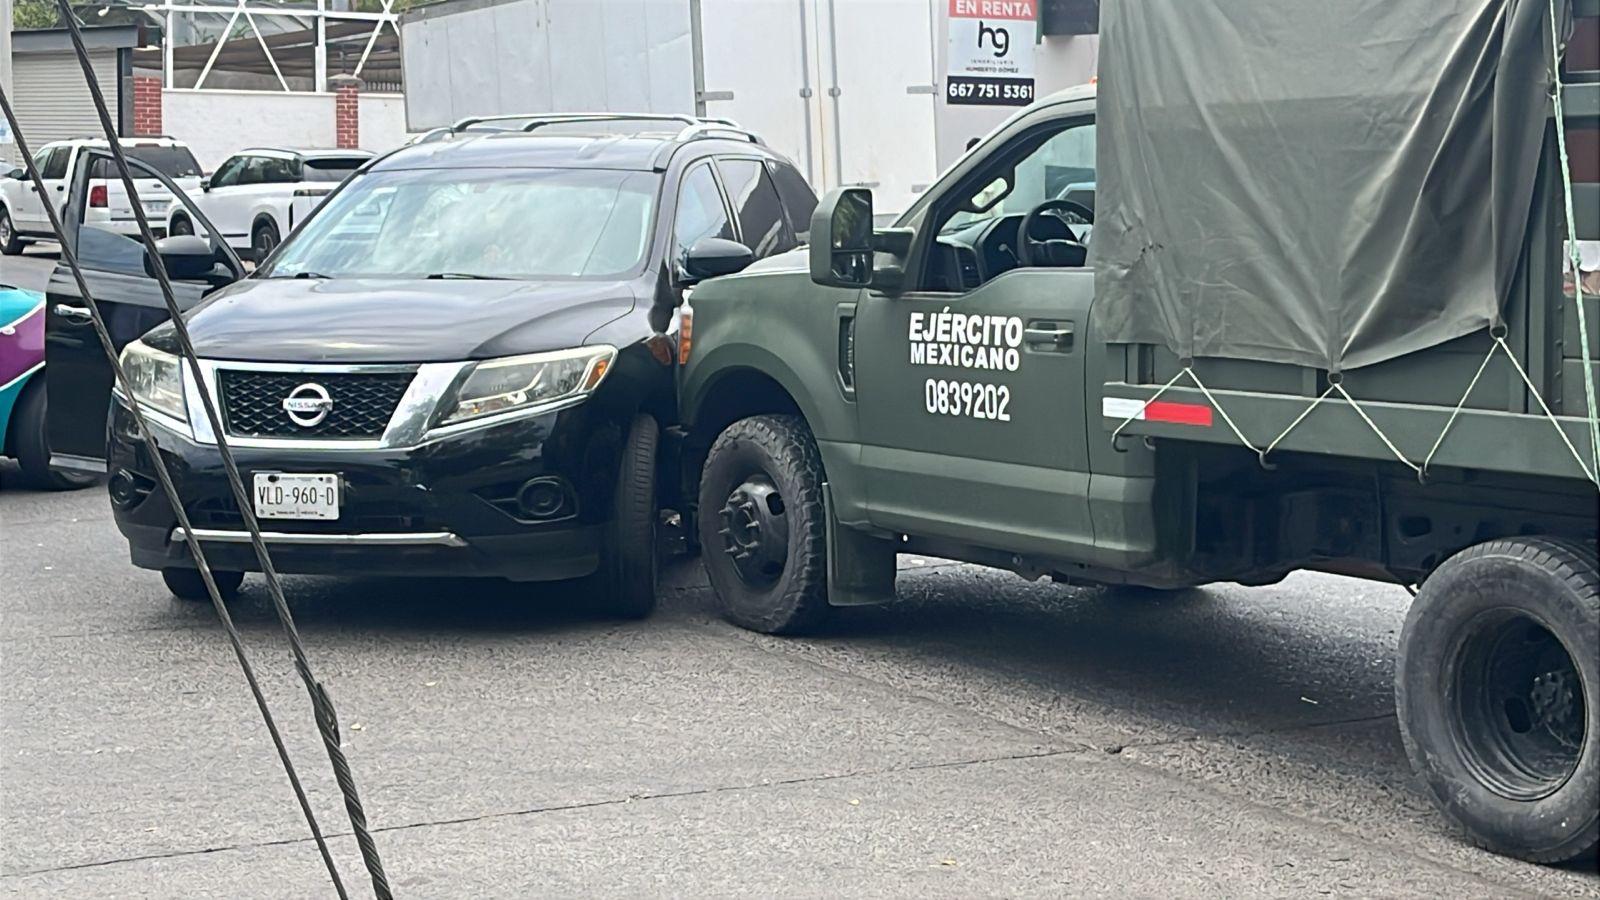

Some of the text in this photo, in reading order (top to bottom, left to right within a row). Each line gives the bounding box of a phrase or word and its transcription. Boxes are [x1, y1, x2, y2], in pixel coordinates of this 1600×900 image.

[956, 0, 1032, 17] EN RENTA
[949, 83, 1033, 99] 667 751 5361
[909, 306, 1023, 348] EJÉRCITO
[910, 342, 1020, 372] MEXICANO
[925, 378, 1011, 422] 0839202
[258, 486, 334, 506] VLD-960-D
